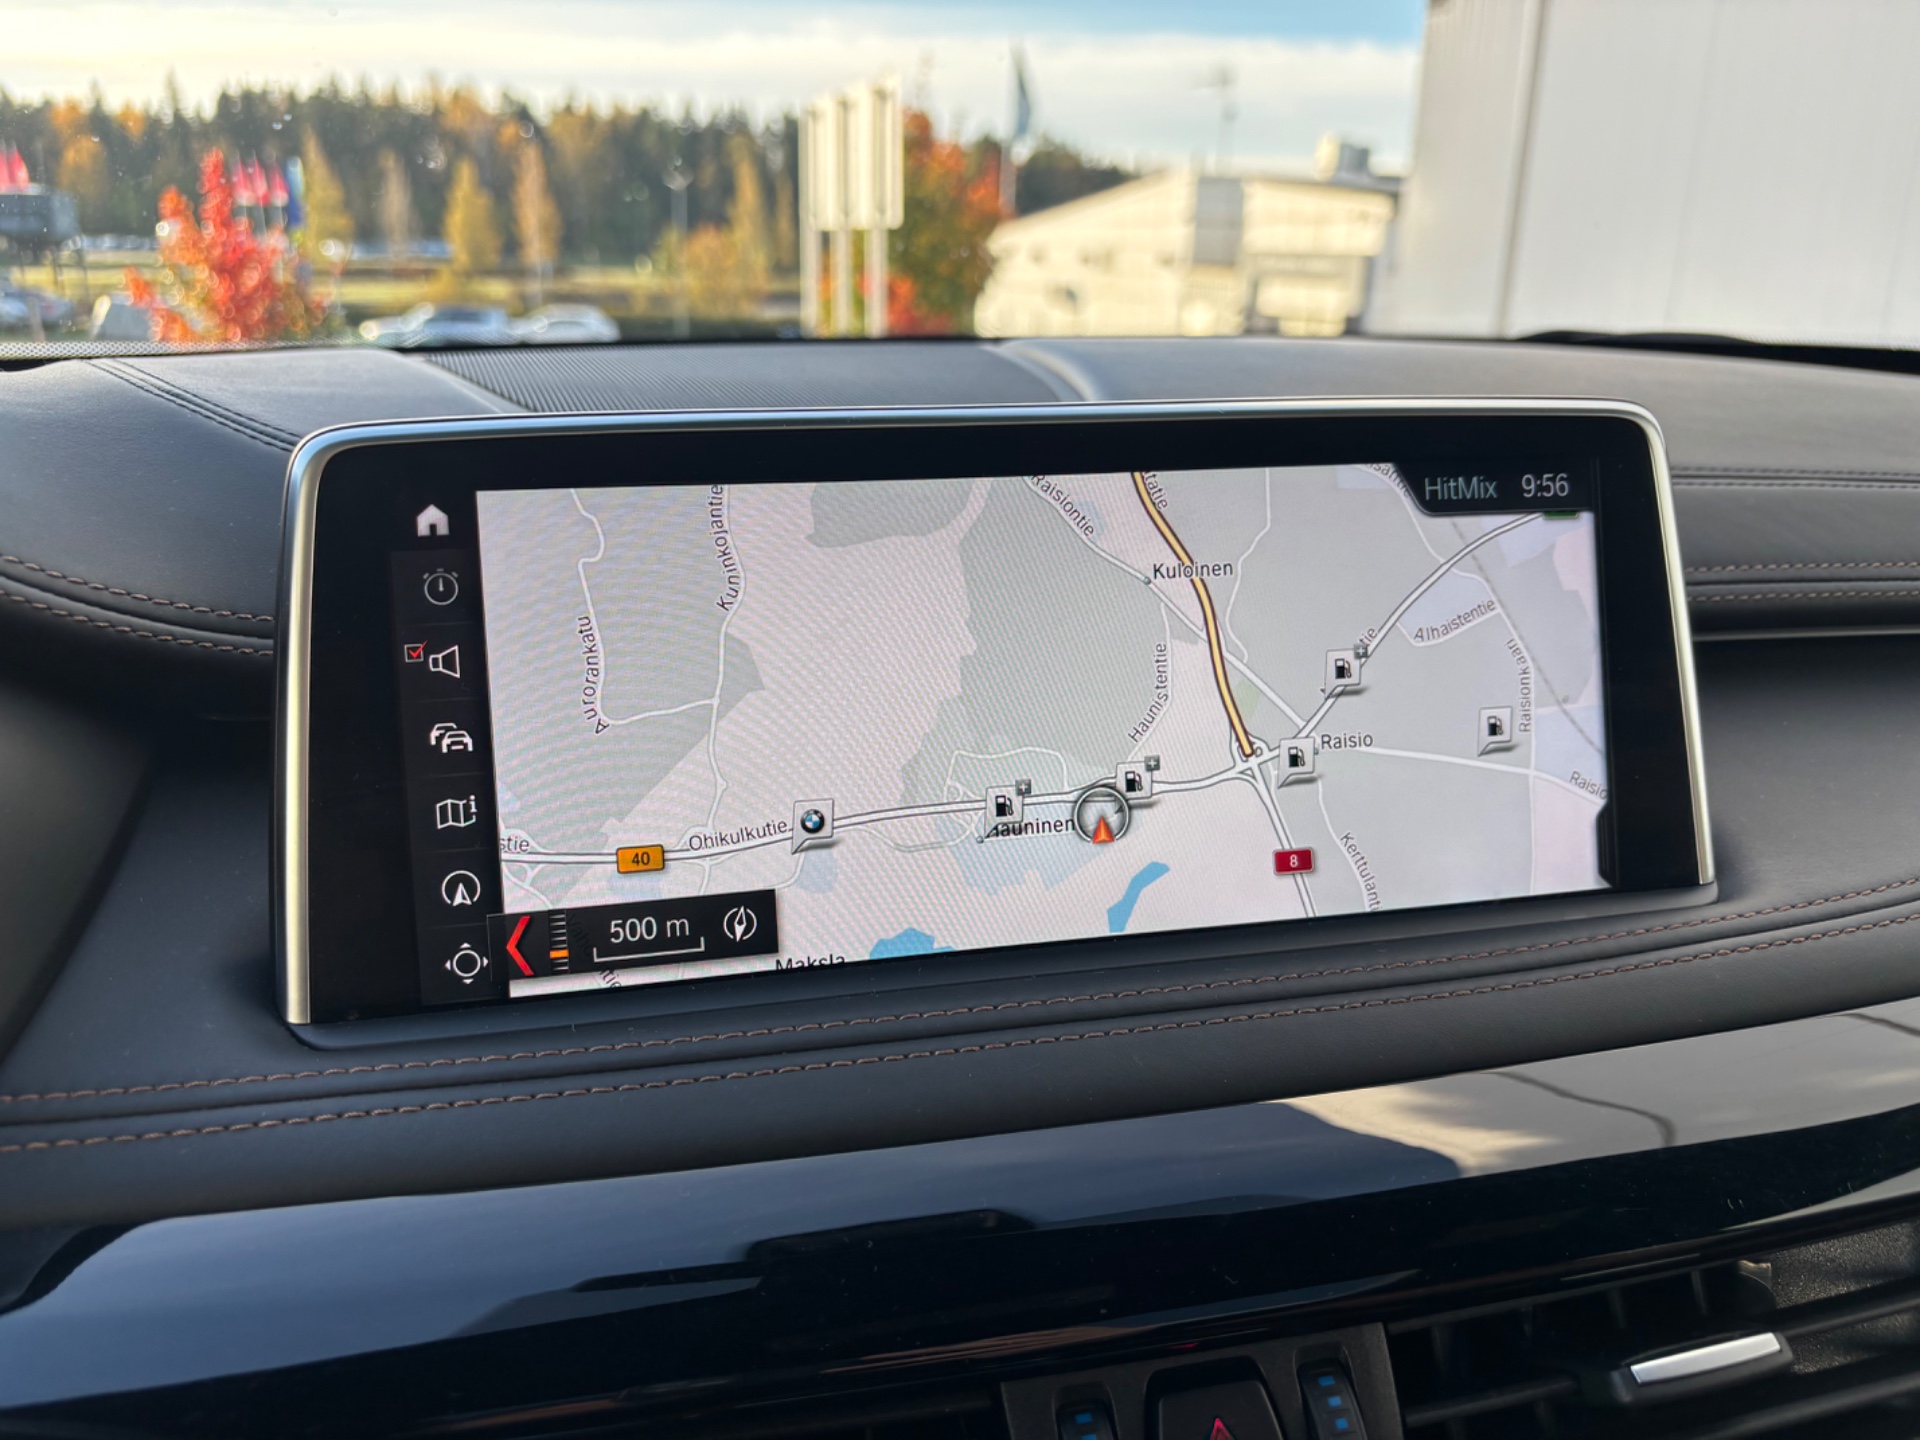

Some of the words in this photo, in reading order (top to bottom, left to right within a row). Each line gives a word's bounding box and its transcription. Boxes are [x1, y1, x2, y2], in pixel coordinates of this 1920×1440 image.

[1424, 475, 1499, 501] HitMix
[1521, 473, 1571, 498] 9:56
[709, 484, 741, 611] Kuninkojantie
[1152, 561, 1234, 581] Kuloinen
[1413, 599, 1497, 641] Alhaistentie
[1127, 642, 1168, 744] Haunistentie
[1503, 637, 1533, 733] Raisionkaari
[1321, 732, 1374, 751] Raisio
[689, 819, 788, 851] Ohikulkutie
[990, 817, 1076, 838] auninen
[631, 850, 651, 868] 40
[1289, 853, 1300, 869] 8
[609, 916, 658, 943] 500
[666, 918, 690, 937] m
